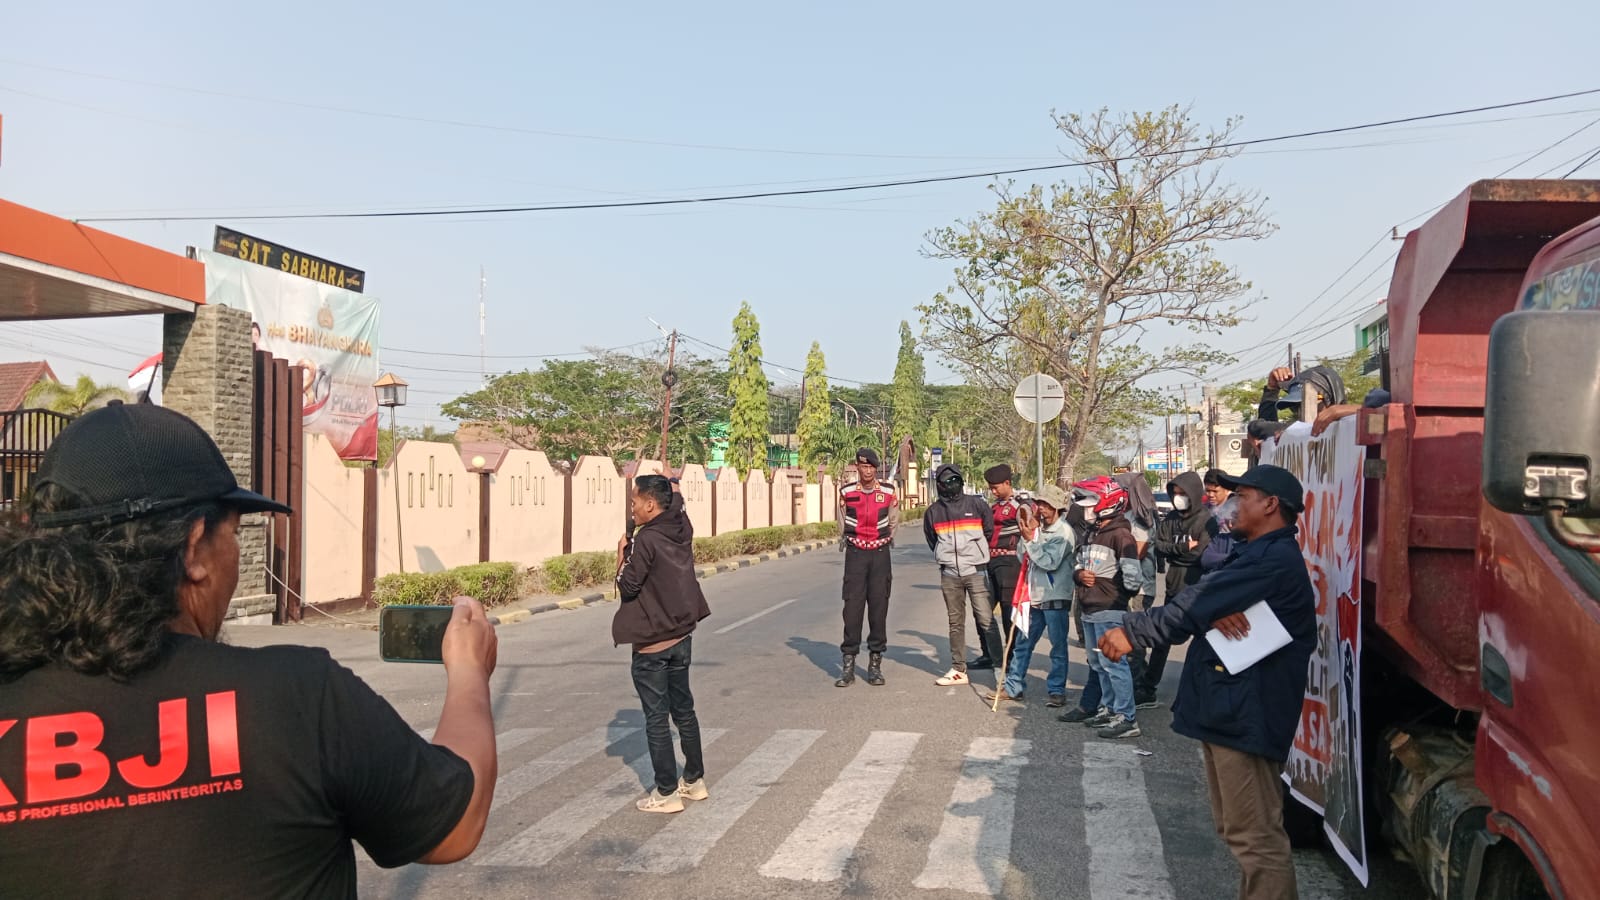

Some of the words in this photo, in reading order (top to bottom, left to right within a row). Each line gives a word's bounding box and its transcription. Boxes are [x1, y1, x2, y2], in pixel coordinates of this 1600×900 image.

[239, 237, 271, 266] SAT
[281, 252, 345, 288] SABHARA
[21, 795, 124, 820] PROFESIONAL
[128, 779, 244, 806] BERINTEGRITAS
